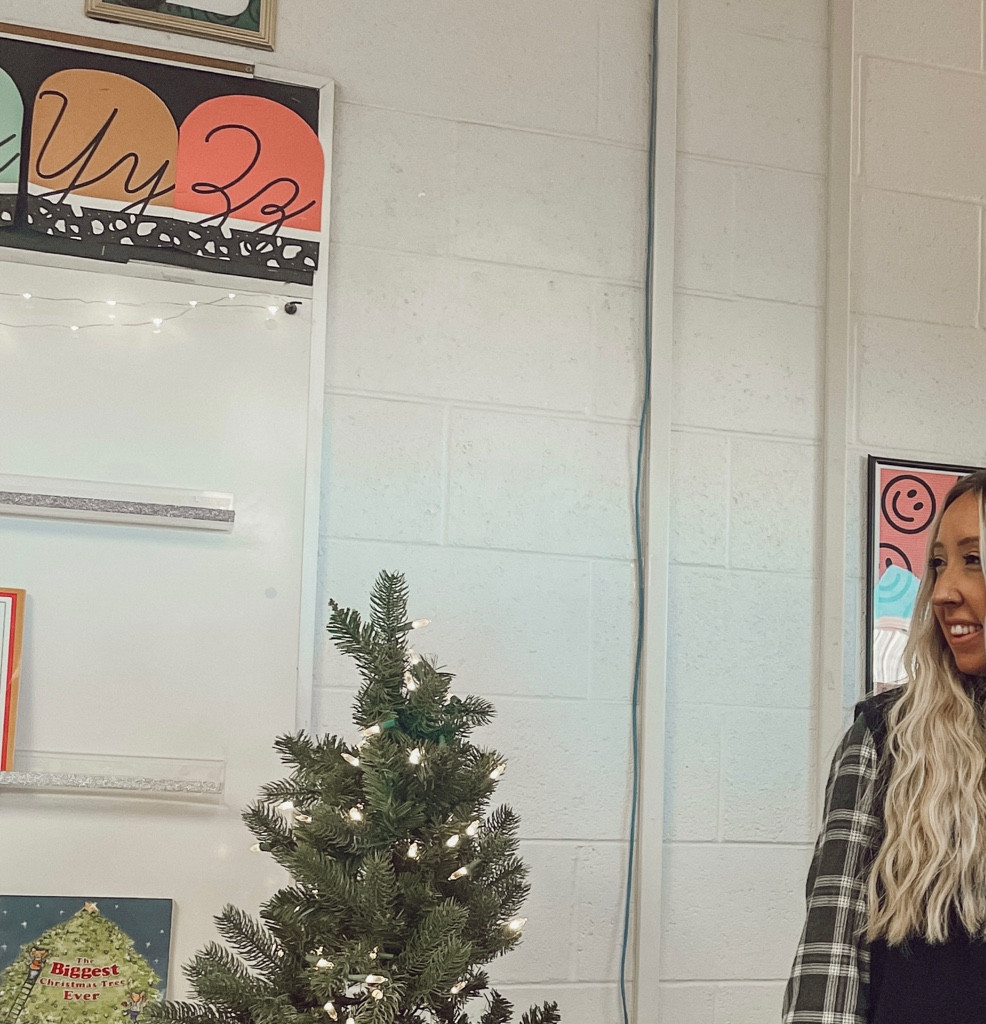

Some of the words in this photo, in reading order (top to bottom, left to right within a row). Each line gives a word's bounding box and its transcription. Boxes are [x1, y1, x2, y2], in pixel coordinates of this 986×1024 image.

[51, 962, 120, 979] Biggest
[40, 978, 97, 988] Christmas
[101, 979, 125, 988] Tree
[64, 990, 100, 1000] Ever
